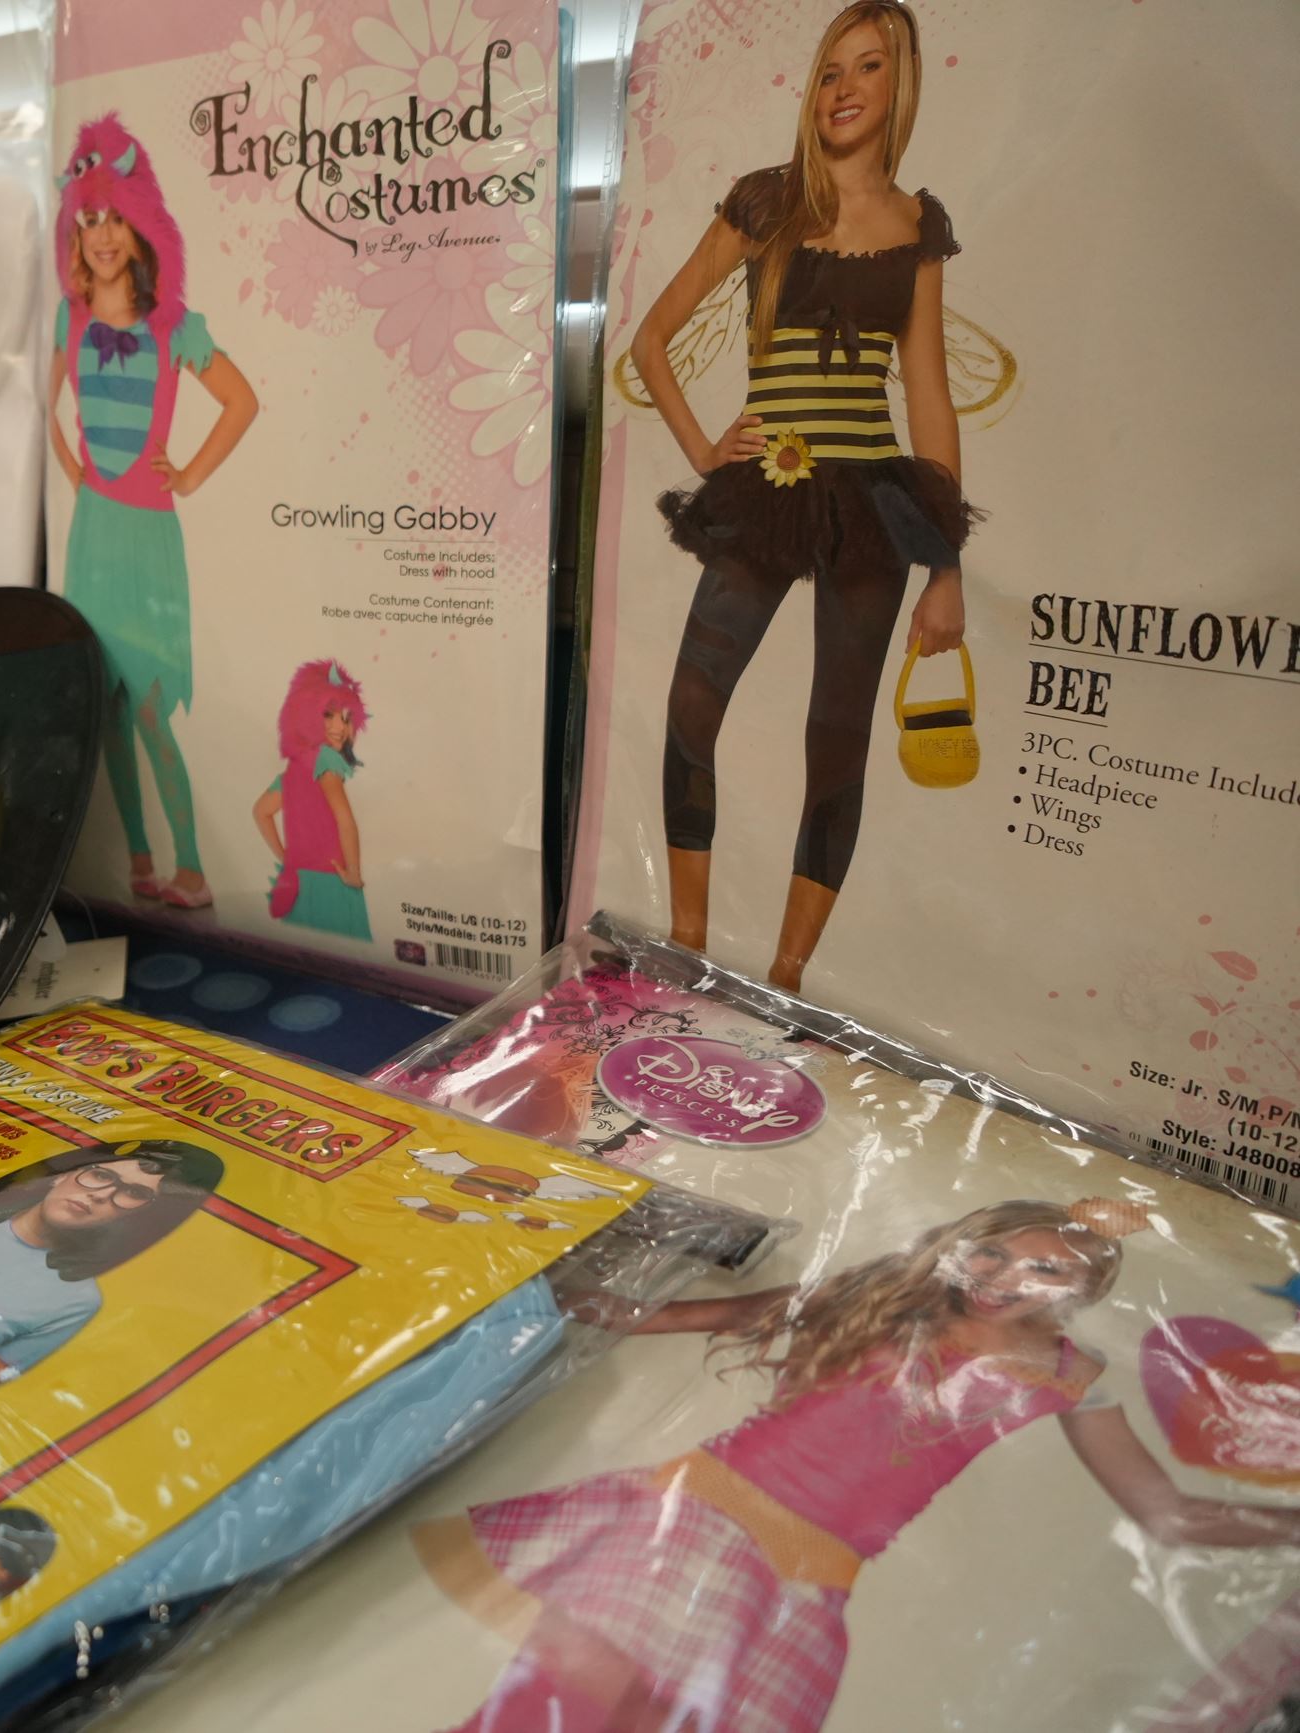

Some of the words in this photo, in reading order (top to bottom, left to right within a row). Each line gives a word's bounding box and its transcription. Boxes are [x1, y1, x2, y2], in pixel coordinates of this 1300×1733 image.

[189, 38, 512, 181] Enchanted
[365, 241, 378, 256] by
[270, 503, 385, 535] Growling
[393, 505, 497, 536] Gabby
[383, 549, 436, 562] Costume
[399, 565, 430, 578] Dress
[432, 565, 457, 578] with
[460, 566, 495, 579] hood
[321, 606, 351, 618] Robe
[353, 609, 382, 621] avec
[384, 610, 438, 625] capuche
[369, 594, 420, 608] Costume
[423, 596, 495, 610] Contenant:
[1025, 660, 1112, 718] BEE
[1020, 732, 1078, 761] 3PC.
[1088, 744, 1200, 785] Costume
[1207, 766, 1300, 806] Includ
[1035, 764, 1159, 810] Headpiece
[1030, 793, 1103, 834] Wings
[1021, 822, 1085, 857] Dress
[401, 902, 457, 923] Size/Taille:
[481, 917, 527, 932] (10-12)
[480, 932, 527, 947] C48175
[1129, 1060, 1176, 1090] Size:
[1181, 1079, 1208, 1100] Jr.
[23, 1080, 125, 1125] COSTUME
[132, 1060, 363, 1164] BURGERS
[634, 1078, 741, 1128] PRINCESS
[1162, 1119, 1217, 1151] Style:
[1227, 1116, 1300, 1157] (10-12
